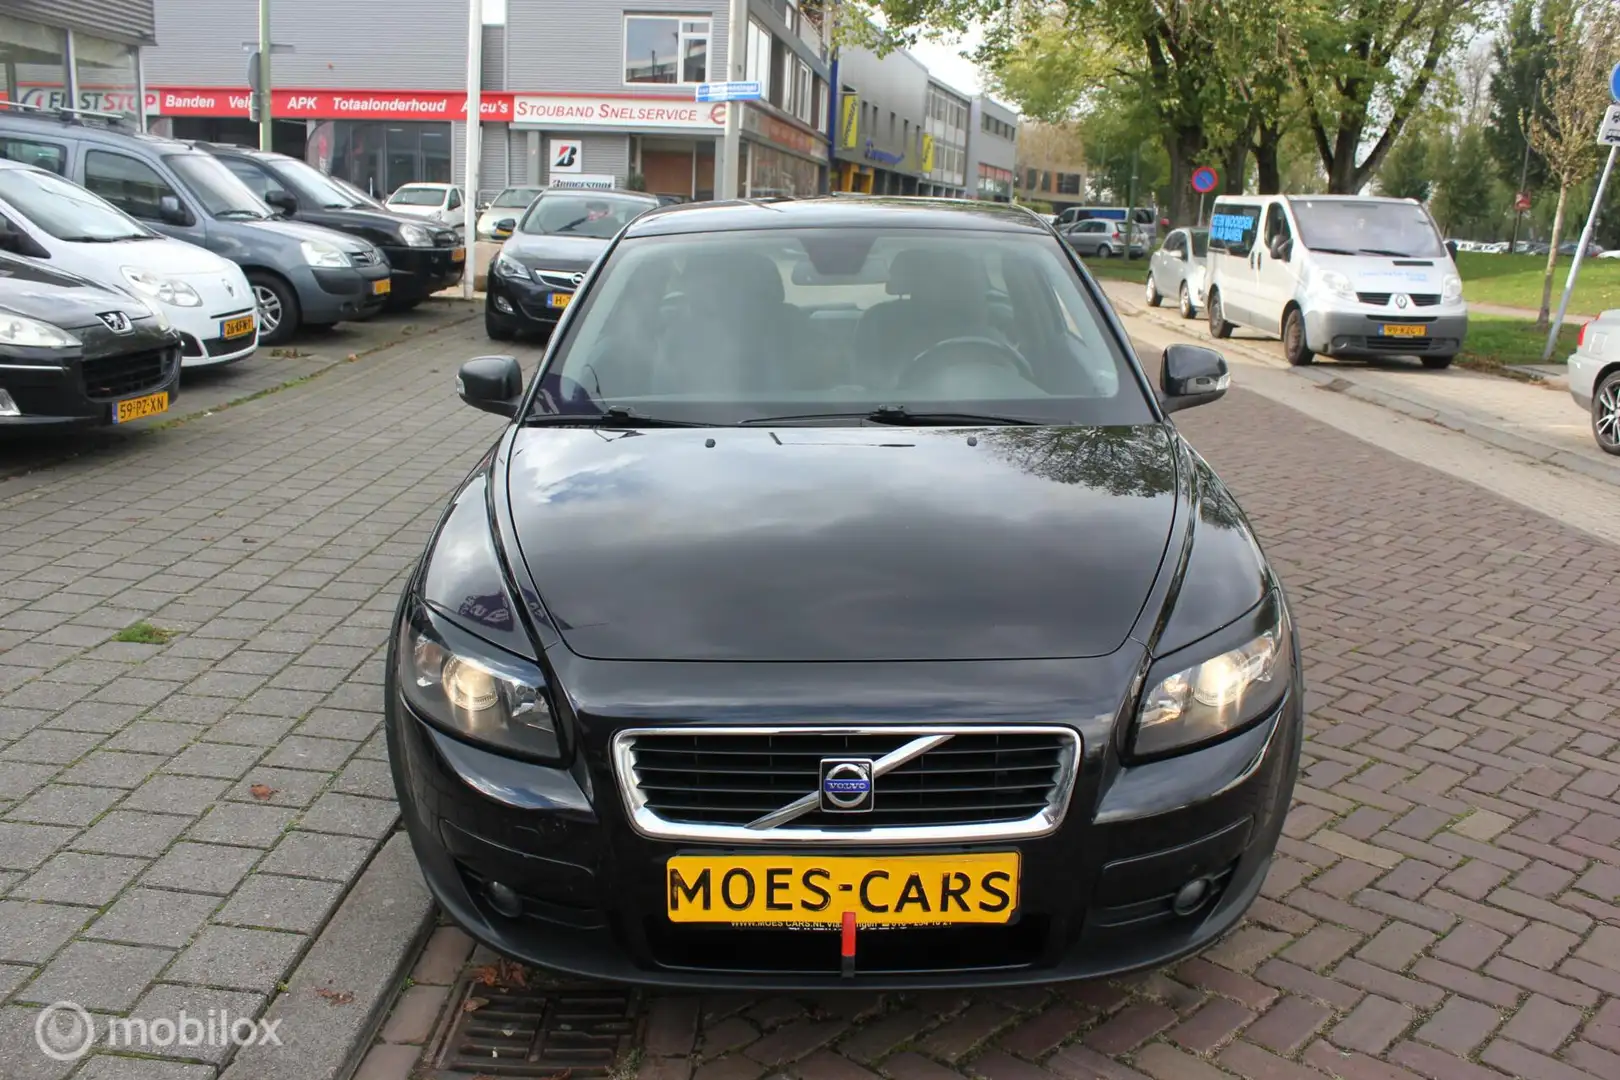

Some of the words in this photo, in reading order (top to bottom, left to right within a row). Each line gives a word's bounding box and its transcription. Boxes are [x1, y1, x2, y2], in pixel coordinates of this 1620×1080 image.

[165, 94, 215, 109] Banden
[287, 97, 318, 110] APK
[332, 97, 447, 113] Totaalonderhoud
[461, 99, 509, 113] Acu's
[516, 101, 594, 118] STOUBAND
[598, 104, 697, 121] SNELSERVICE
[120, 400, 164, 419] 59-PZ-XN
[827, 781, 867, 790] VOLVO
[668, 867, 1011, 914] MOES-CARS
